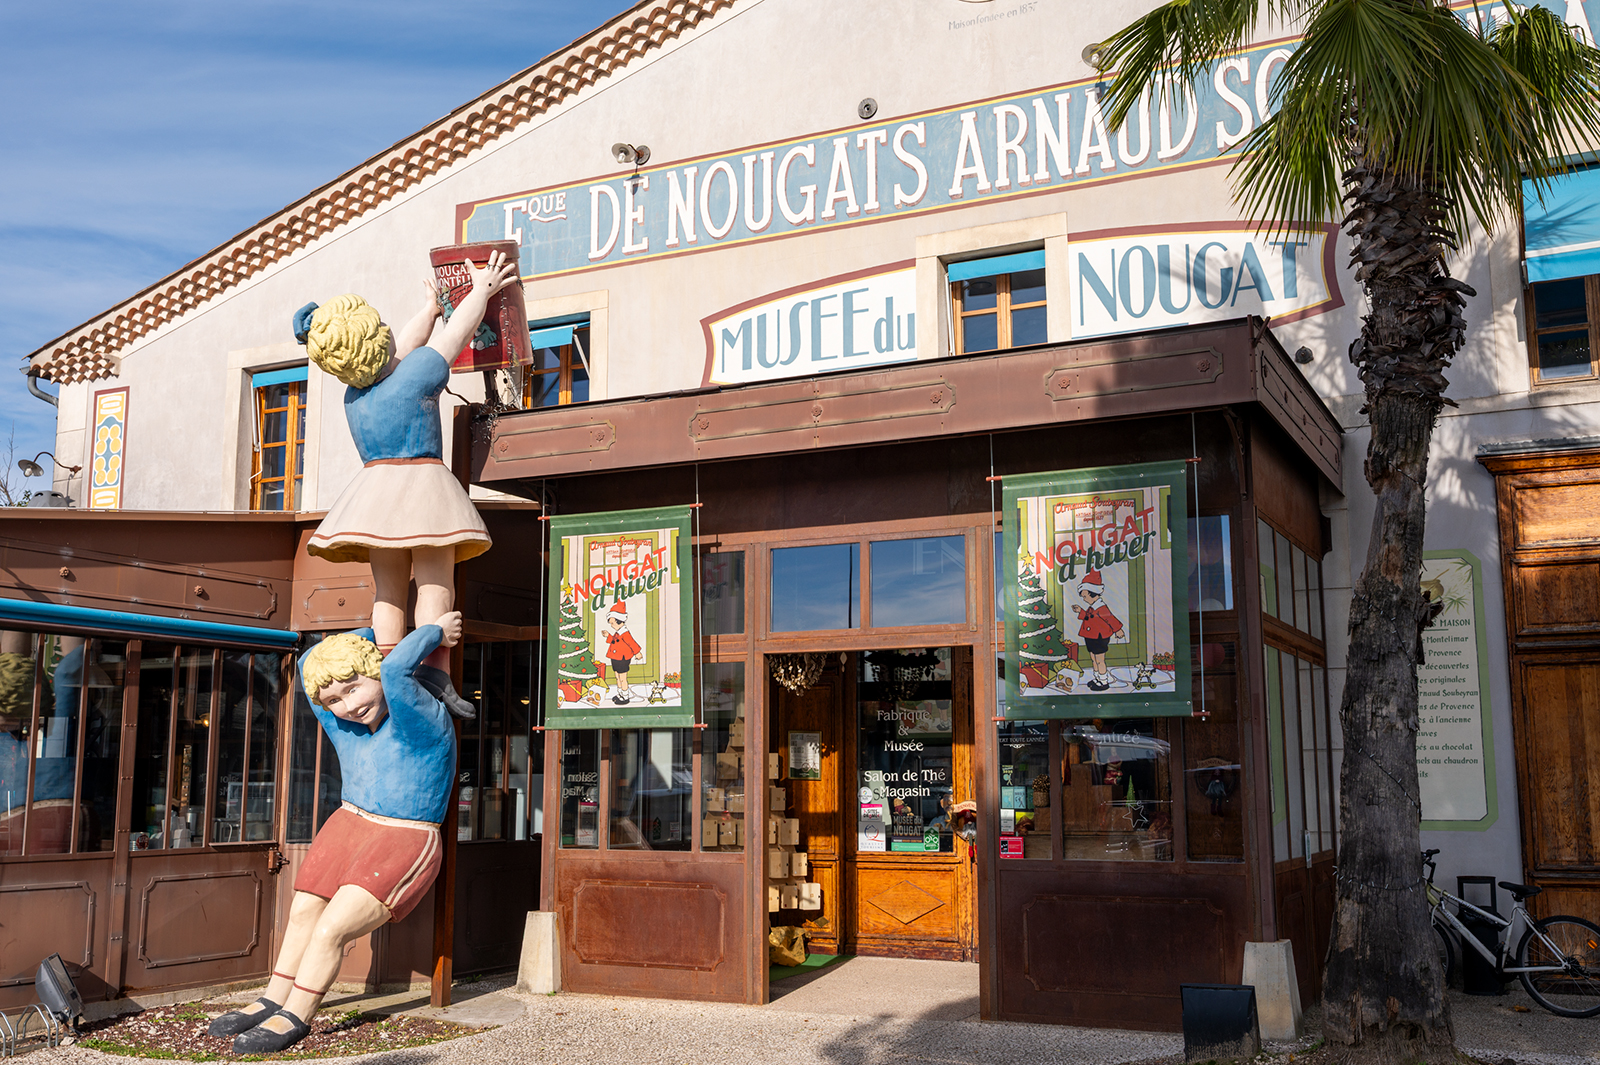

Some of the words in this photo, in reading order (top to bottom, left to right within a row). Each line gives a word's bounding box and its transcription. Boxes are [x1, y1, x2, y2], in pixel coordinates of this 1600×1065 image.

[1006, 9, 1018, 18] en
[588, 175, 650, 262] DE
[665, 121, 929, 248] NOUGATS
[948, 71, 1199, 200] ARNAUD
[1077, 241, 1308, 326] NOUGAT
[721, 287, 870, 374] MUSEE
[873, 296, 916, 354] du
[1054, 499, 1087, 514] Arnaud
[1088, 495, 1134, 510] Soubeyran
[589, 538, 616, 551] Arnaud
[1034, 506, 1155, 575] NOUGAT
[1058, 530, 1157, 584] d'hiver
[574, 546, 667, 604] NOUGAT
[592, 567, 668, 611] d'hiver
[1440, 618, 1471, 627] MAISON
[1428, 649, 1462, 657] Provence
[1425, 662, 1470, 670] découvertes
[1429, 674, 1466, 686] originales
[1418, 689, 1441, 697] rnaud
[1442, 688, 1479, 699] Soubeyran
[1440, 702, 1475, 710] Provence
[877, 709, 931, 723] Fabrique
[1429, 715, 1434, 724] à
[1435, 715, 1472, 724] l'ancienne
[897, 724, 910, 736] &
[883, 738, 925, 752] Musée
[1441, 742, 1473, 751] chocolat
[1443, 756, 1479, 765] chaudron
[863, 769, 899, 782] Salon
[902, 769, 919, 782] de
[920, 767, 947, 781] Thé
[879, 784, 931, 800] Magasin
[892, 825, 922, 836] NOUGAT
